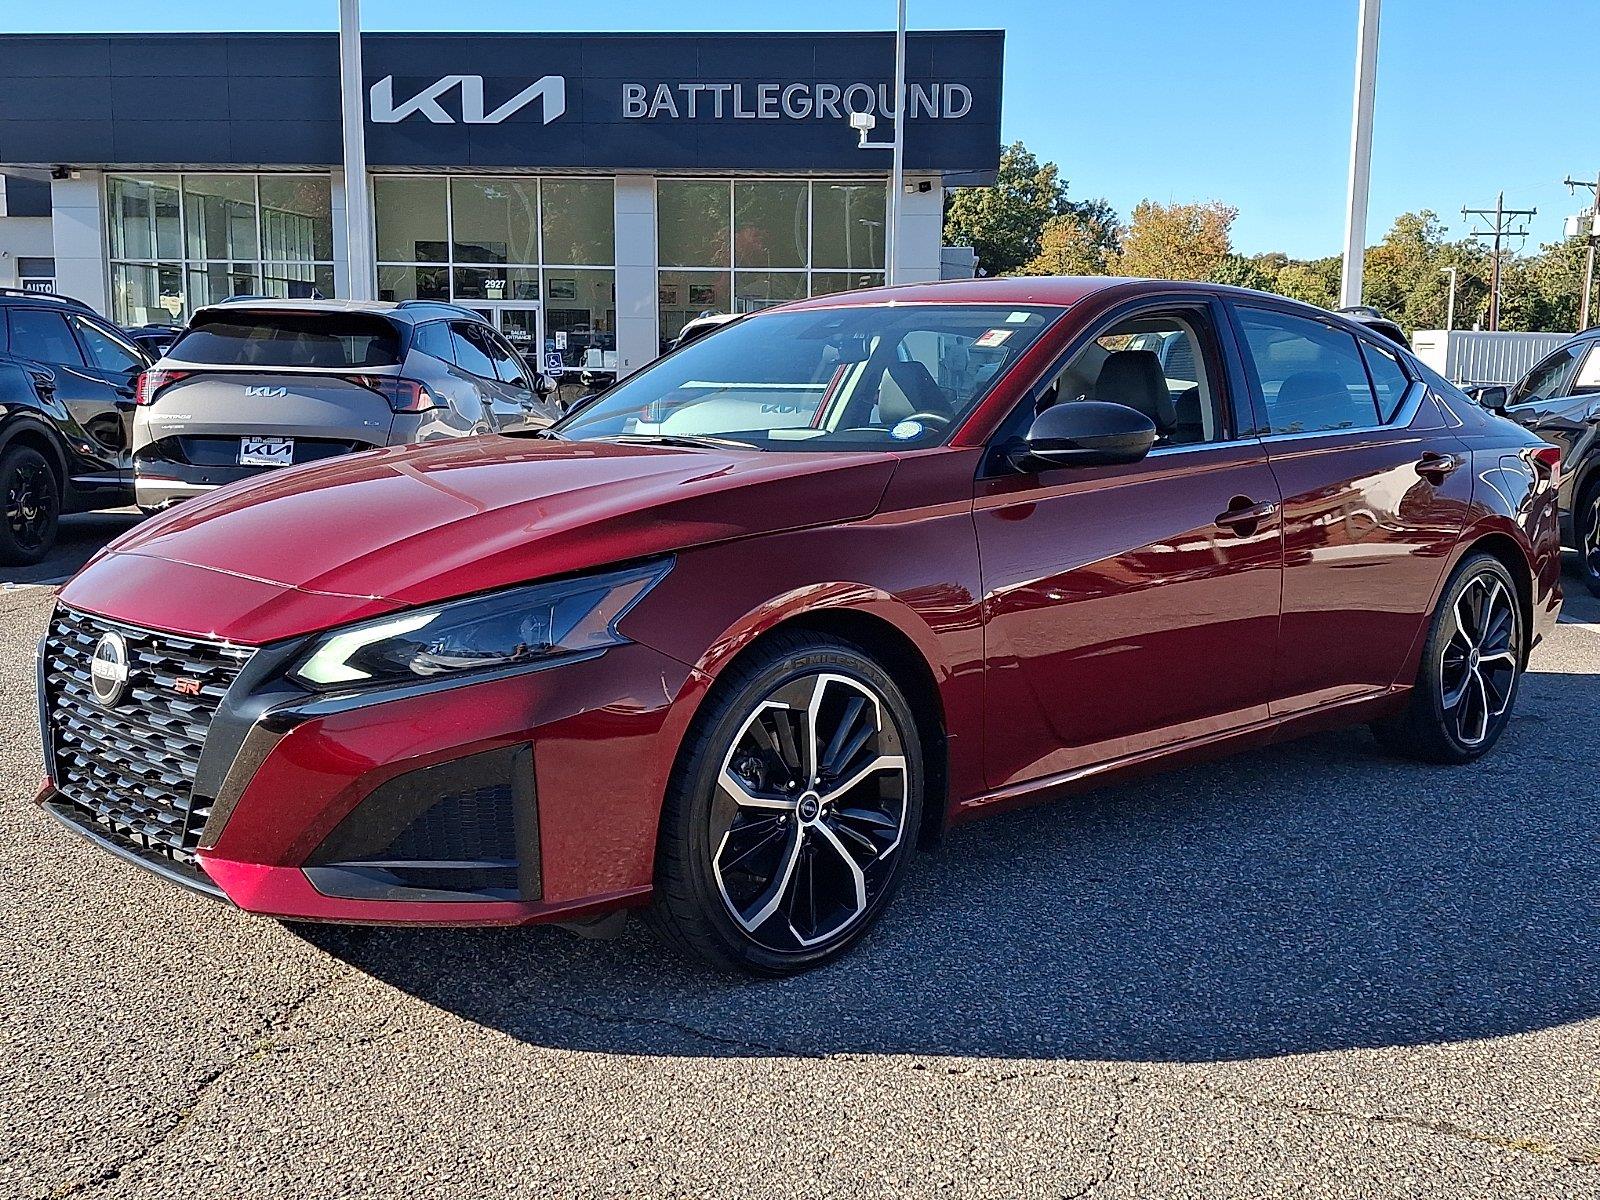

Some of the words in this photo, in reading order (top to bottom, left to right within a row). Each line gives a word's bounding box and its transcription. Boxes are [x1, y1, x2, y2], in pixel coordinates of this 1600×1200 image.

[370, 74, 566, 125] KIA
[621, 82, 973, 119] BATTLEGROUND
[26, 283, 52, 294] AUTO
[485, 280, 506, 289] 2927
[245, 386, 287, 398] KIA
[243, 443, 292, 456] KIA
[174, 677, 203, 695] SR
